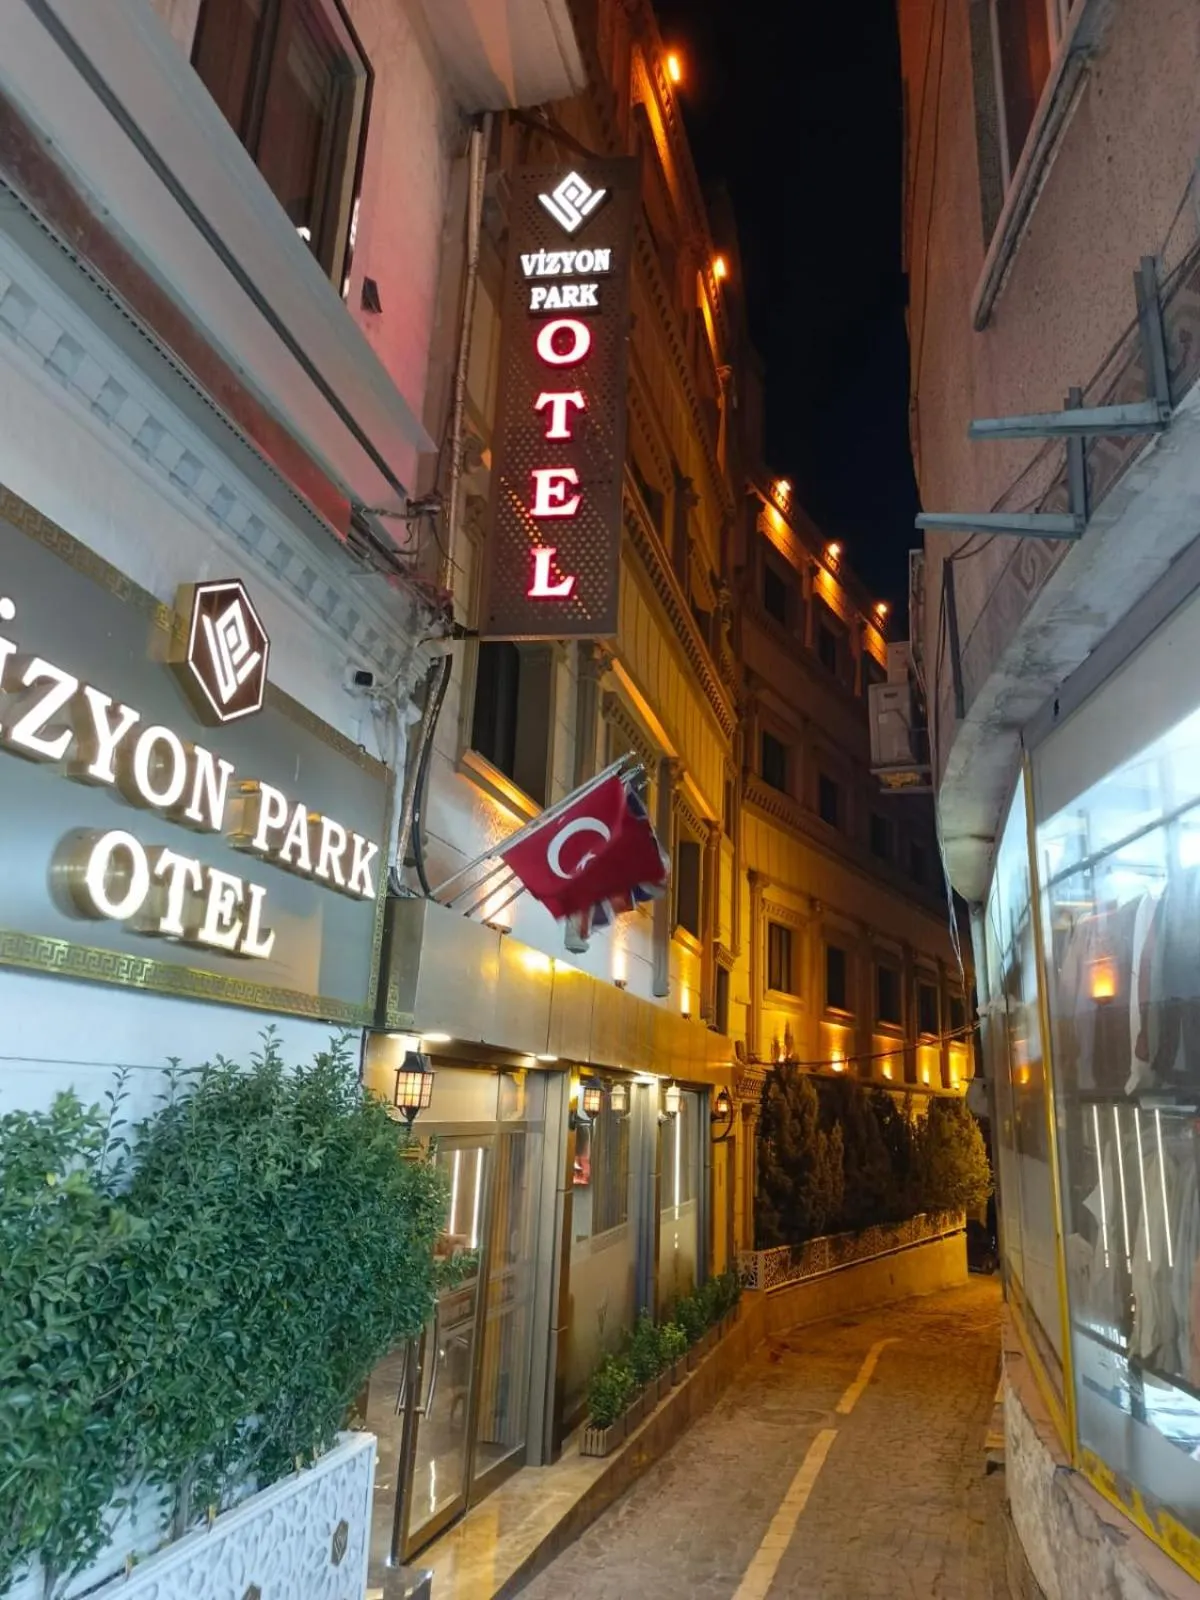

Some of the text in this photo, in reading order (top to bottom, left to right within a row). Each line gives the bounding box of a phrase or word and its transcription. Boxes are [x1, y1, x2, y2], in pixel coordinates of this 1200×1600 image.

[520, 248, 611, 276] VİZYON
[530, 284, 598, 310] PARK
[528, 319, 591, 597] OTEL
[86, 830, 275, 958] OTEL
[252, 780, 379, 899] PARK
